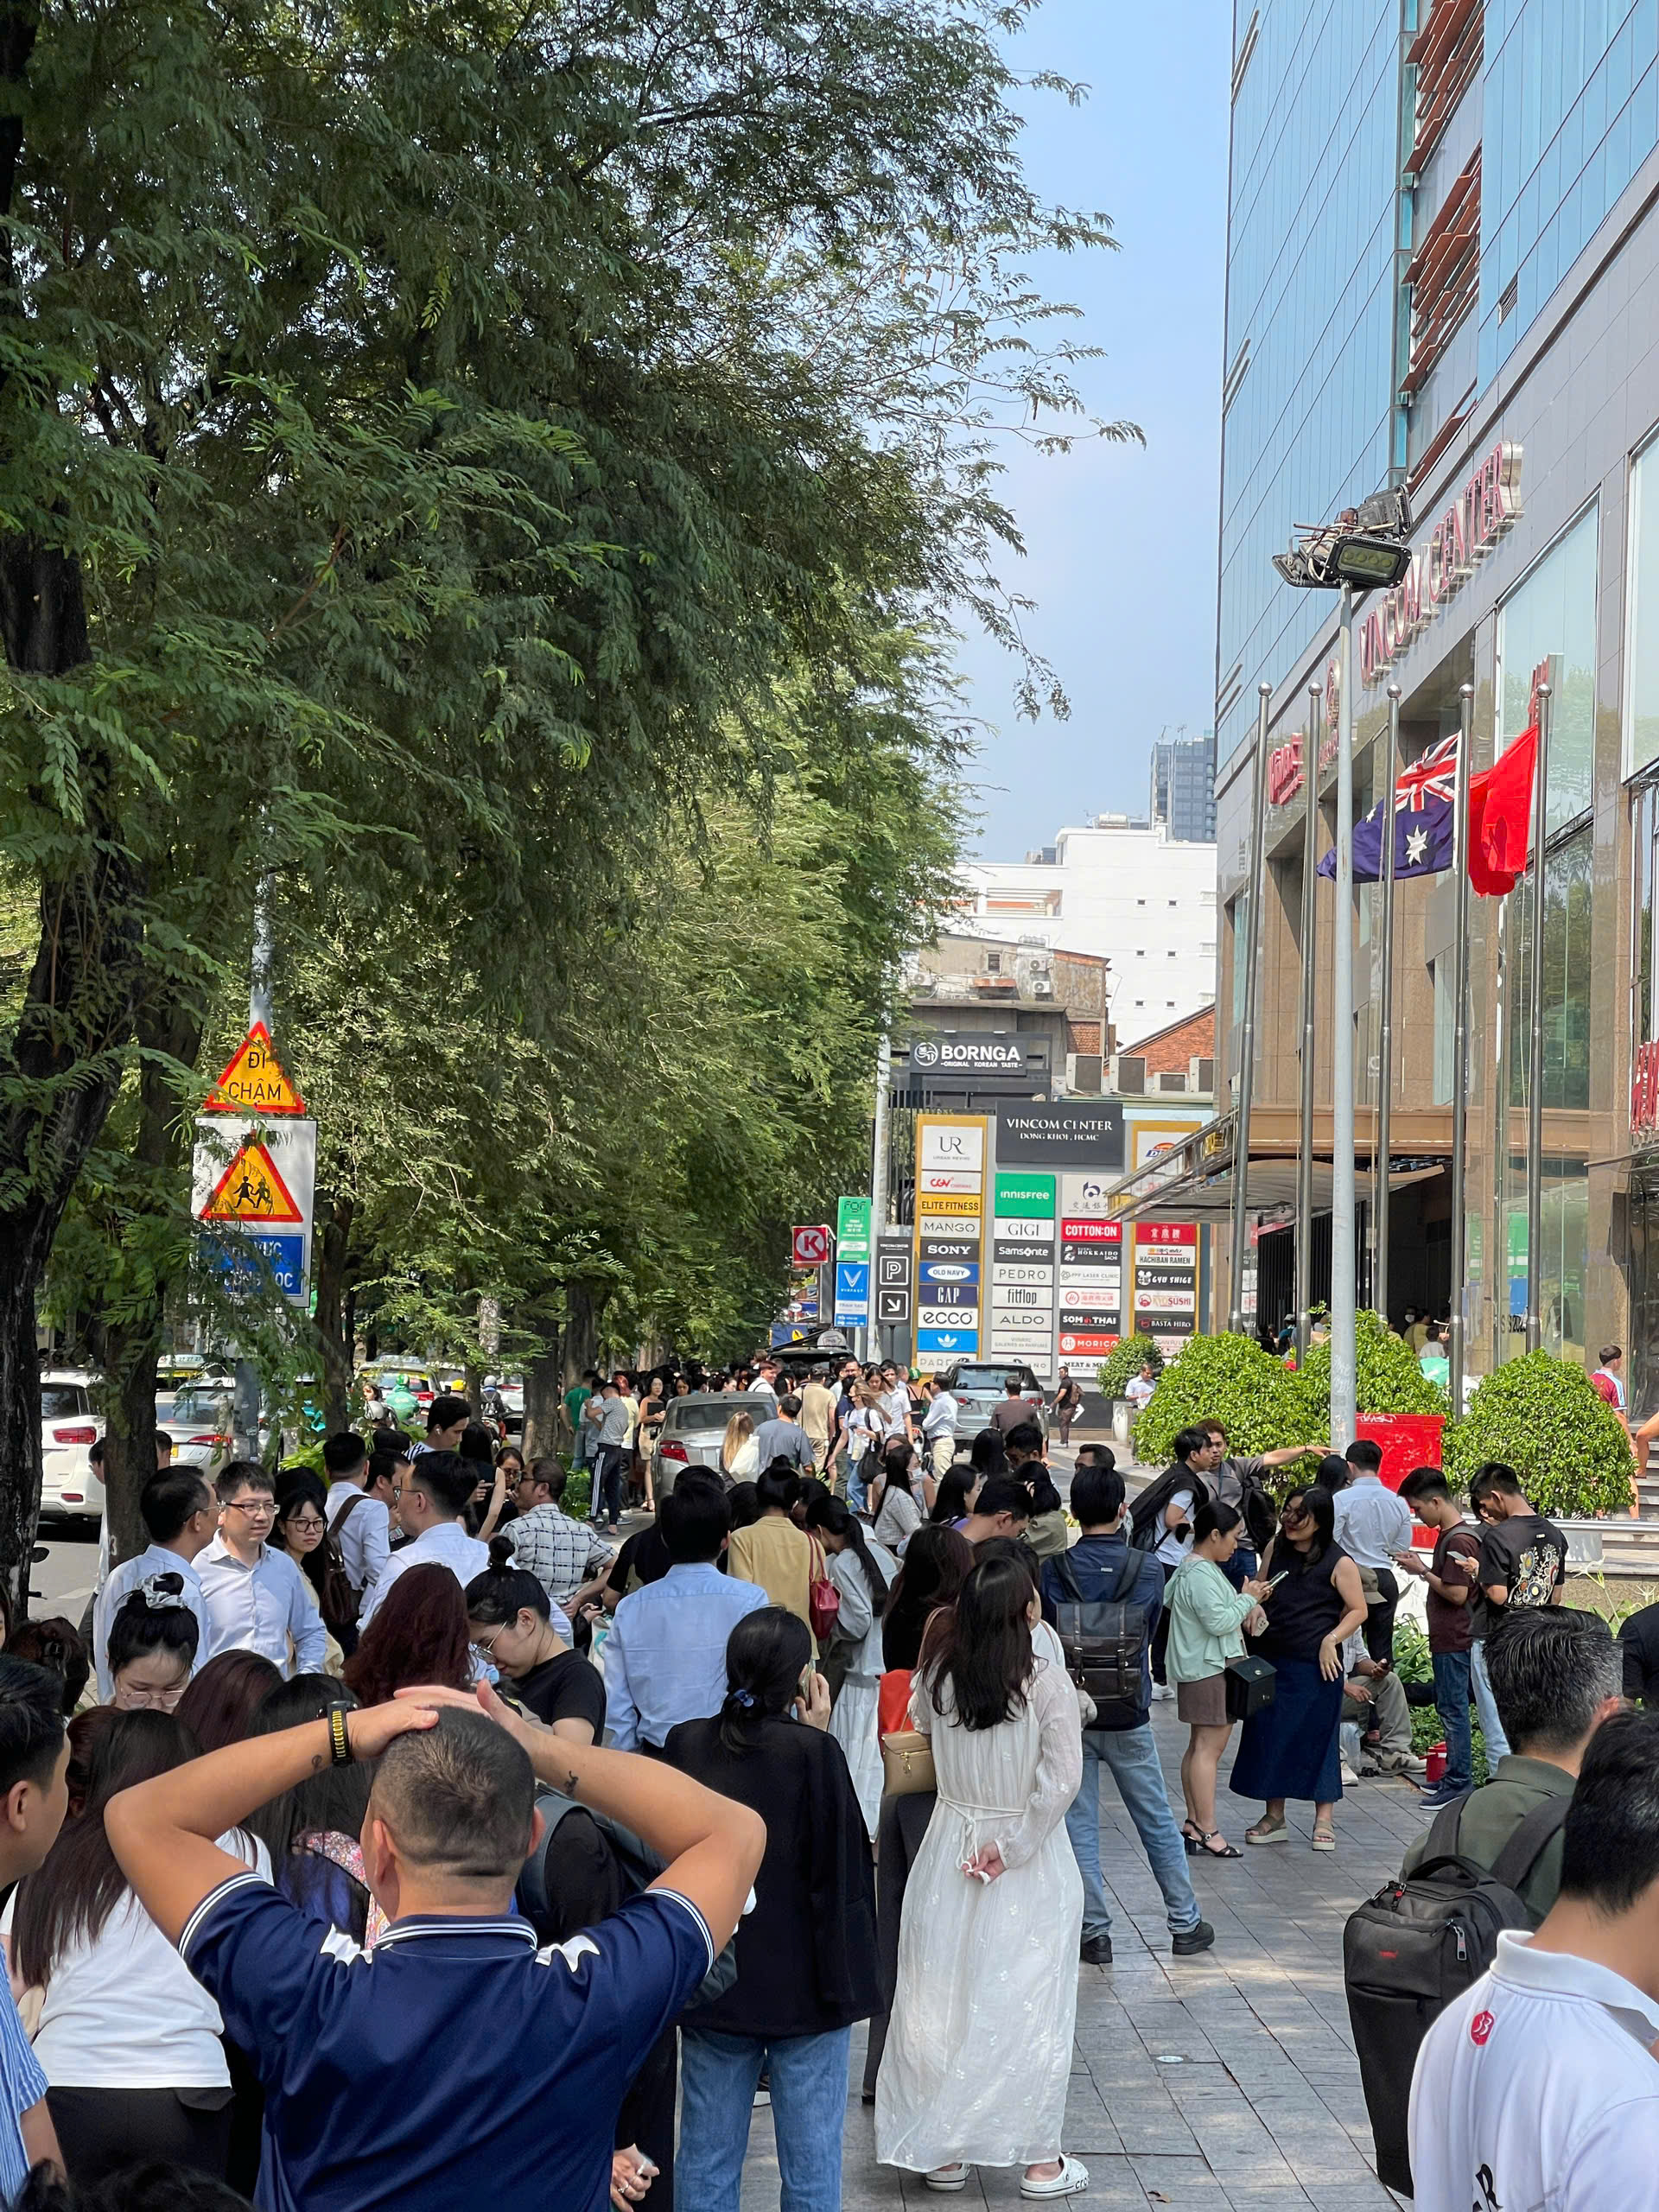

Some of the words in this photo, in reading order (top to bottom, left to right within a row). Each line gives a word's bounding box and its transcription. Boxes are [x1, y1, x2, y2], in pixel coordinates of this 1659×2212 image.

[941, 1045, 1020, 1061] BORNGA
[248, 1051, 265, 1070] ĐI
[1007, 1118, 1059, 1130] VINCOM
[938, 1136, 965, 1155] UR
[930, 1178, 951, 1188] CGV
[921, 1201, 944, 1210] ELITE
[945, 1201, 979, 1211] FITNESS
[924, 1222, 976, 1232] MANGO
[1007, 1223, 1039, 1236] GIGI
[927, 1244, 972, 1255] SONY
[998, 1246, 1049, 1256] Samsonite
[887, 1262, 901, 1280] P
[999, 1268, 1046, 1280] PEDRO
[938, 1287, 960, 1304] GAP
[1007, 1288, 1037, 1306] fitflop
[923, 1312, 972, 1325] ecco
[1000, 1315, 1045, 1325] ALDO
[1062, 1315, 1084, 1324] SOM
[1091, 1316, 1116, 1325] THAI
